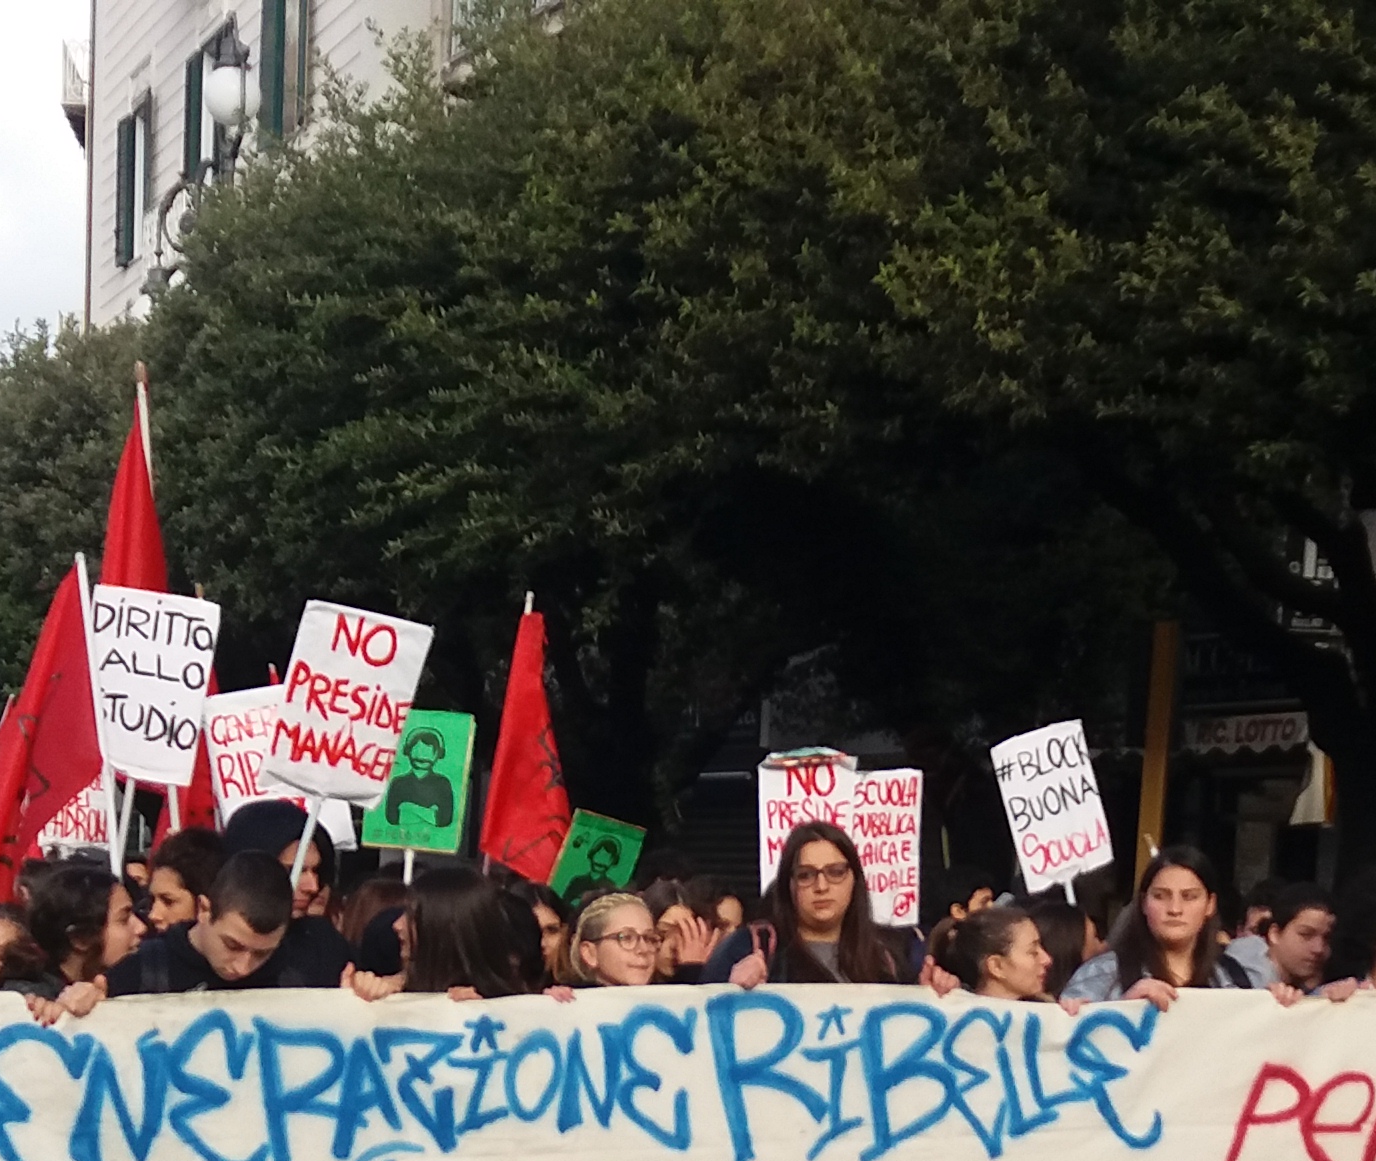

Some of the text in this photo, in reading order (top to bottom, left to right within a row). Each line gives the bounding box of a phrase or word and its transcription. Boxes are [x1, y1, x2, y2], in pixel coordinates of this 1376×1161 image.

[93, 597, 214, 651] DIRITTO
[331, 612, 398, 667] NO
[99, 648, 205, 690] ALLO
[285, 659, 412, 735] PRESIDE
[1234, 717, 1297, 743] LOTTO
[785, 763, 836, 797] NO
[853, 776, 918, 809] SCUOLA
[766, 798, 852, 832] PRESIDE
[1008, 774, 1100, 832] BUONA
[851, 811, 916, 840] PUBBLICA
[901, 840, 912, 862] E
